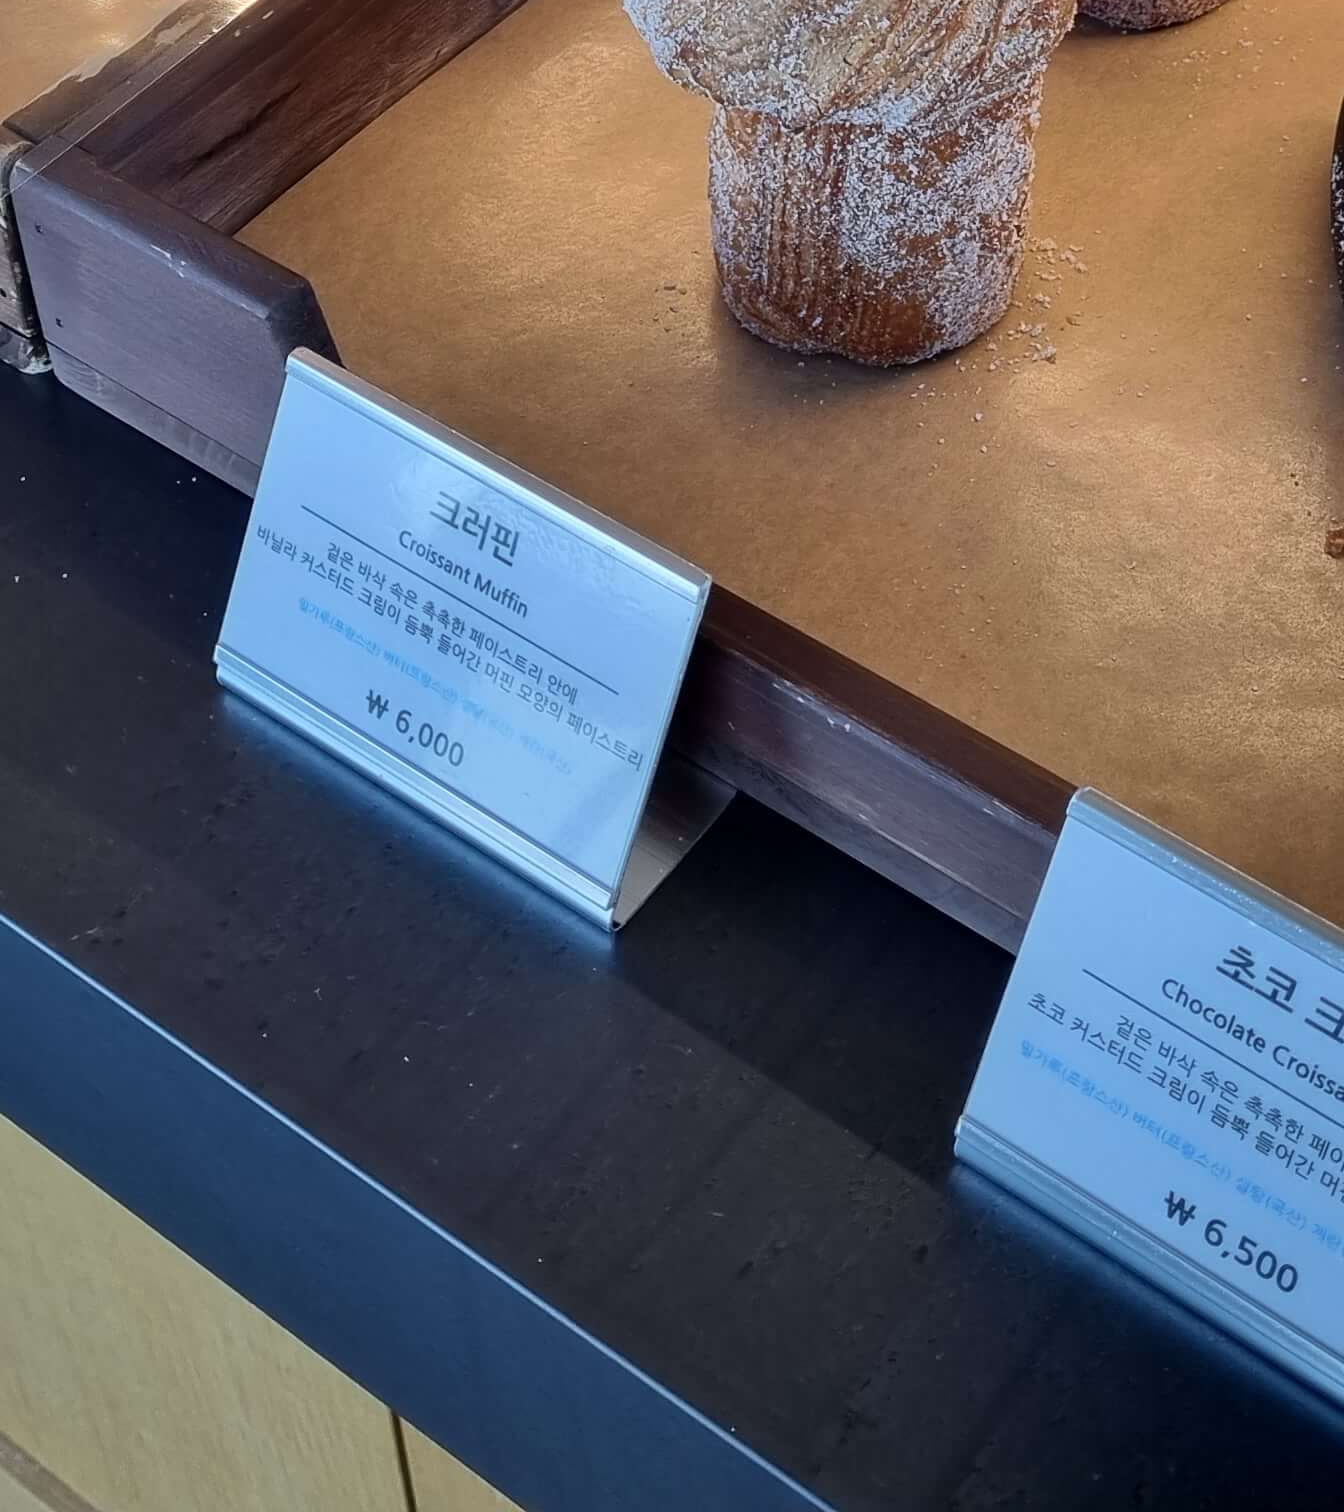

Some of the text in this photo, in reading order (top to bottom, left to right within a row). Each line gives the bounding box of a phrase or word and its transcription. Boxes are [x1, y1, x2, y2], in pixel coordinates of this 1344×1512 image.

[429, 491, 520, 568] 크러핀
[399, 530, 528, 618] Croissant Muffin
[256, 524, 297, 561] 바닐라
[300, 551, 355, 596] 커스터드
[357, 587, 401, 625] 크림이
[404, 614, 434, 645] 듬뿍
[437, 633, 481, 673] 들어간
[484, 662, 515, 694] 머핀
[516, 683, 564, 723] 모양의
[566, 712, 644, 772] 페이스트리
[327, 542, 578, 706] 겉은 바삭 속은 촉촉한 페이스트리 안에
[395, 709, 464, 767] 6,000
[1161, 978, 1266, 1054] Chocolate
[1215, 945, 1298, 1014] 초코
[1027, 992, 1066, 1025] 초코
[1069, 1016, 1144, 1074] 커스터드
[1146, 1065, 1206, 1115] 크림이
[1210, 1103, 1251, 1141] 듬뿍
[1255, 1130, 1315, 1181] 들어간
[1116, 1015, 1152, 1052] 겉은
[1157, 1040, 1196, 1078] 바삭
[1200, 1070, 1239, 1105] 속은
[1243, 1095, 1305, 1145] 촉촉한
[1204, 1219, 1298, 1293] 6,500
